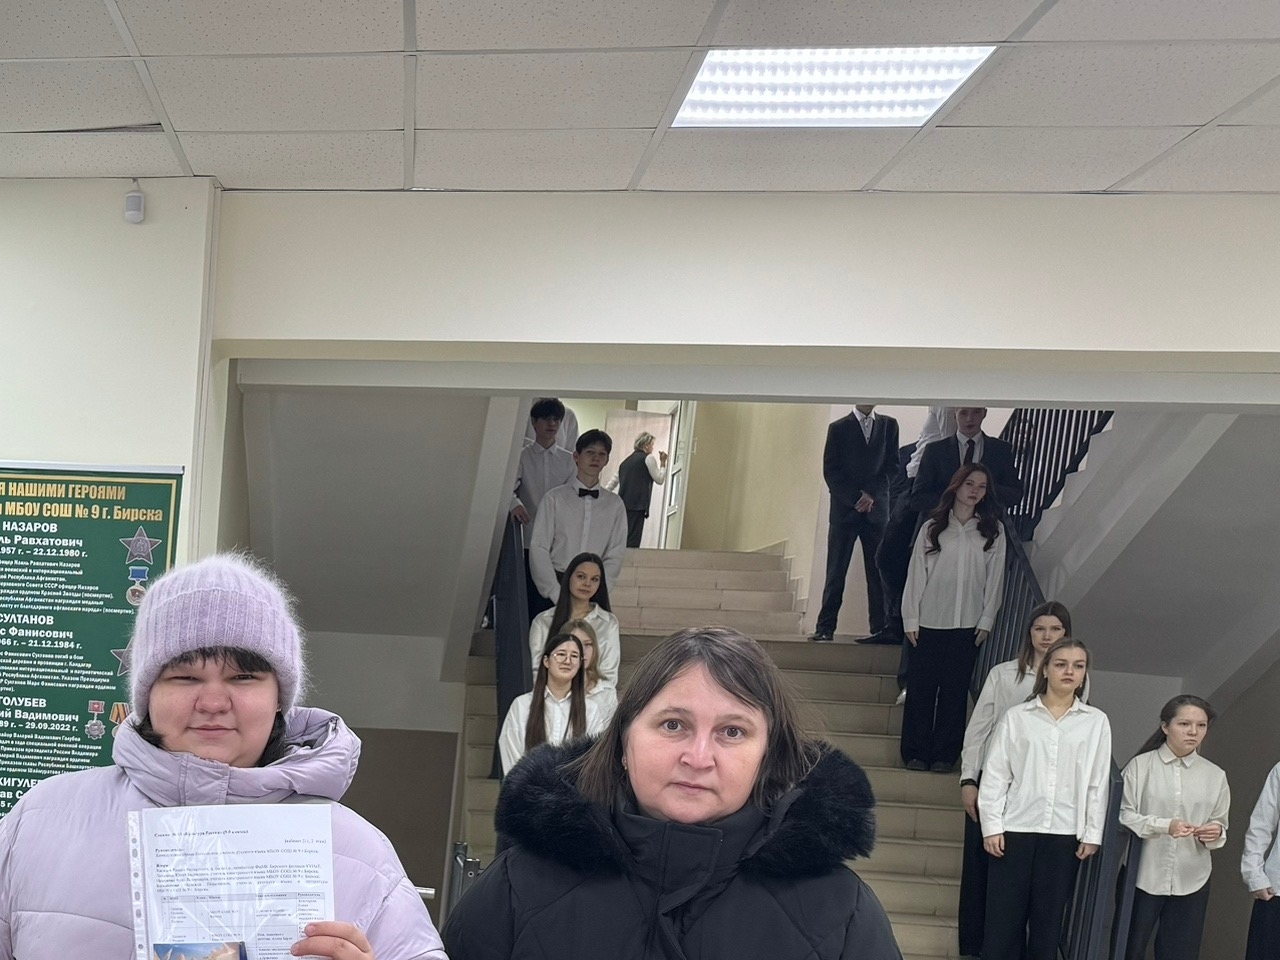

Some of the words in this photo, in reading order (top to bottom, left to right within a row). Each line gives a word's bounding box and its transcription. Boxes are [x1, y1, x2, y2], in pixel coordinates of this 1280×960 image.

[8, 481, 65, 498] НАШИМИ
[68, 484, 125, 500] ГЕРОЯМИ
[4, 501, 40, 516] МБОУ
[42, 502, 72, 517] СОШ
[74, 503, 88, 518] №
[91, 504, 99, 518] 9
[102, 507, 110, 519] г.
[113, 505, 162, 522] Бирска
[2, 520, 57, 532] НАЗАРОВ
[13, 534, 82, 547] Равхатович
[32, 547, 80, 557] 22.12.1980
[8, 627, 73, 639] Фанисович
[27, 639, 74, 648] 21.12.1984
[14, 709, 78, 722] Вадимович
[25, 721, 70, 731] 29.09.2022
